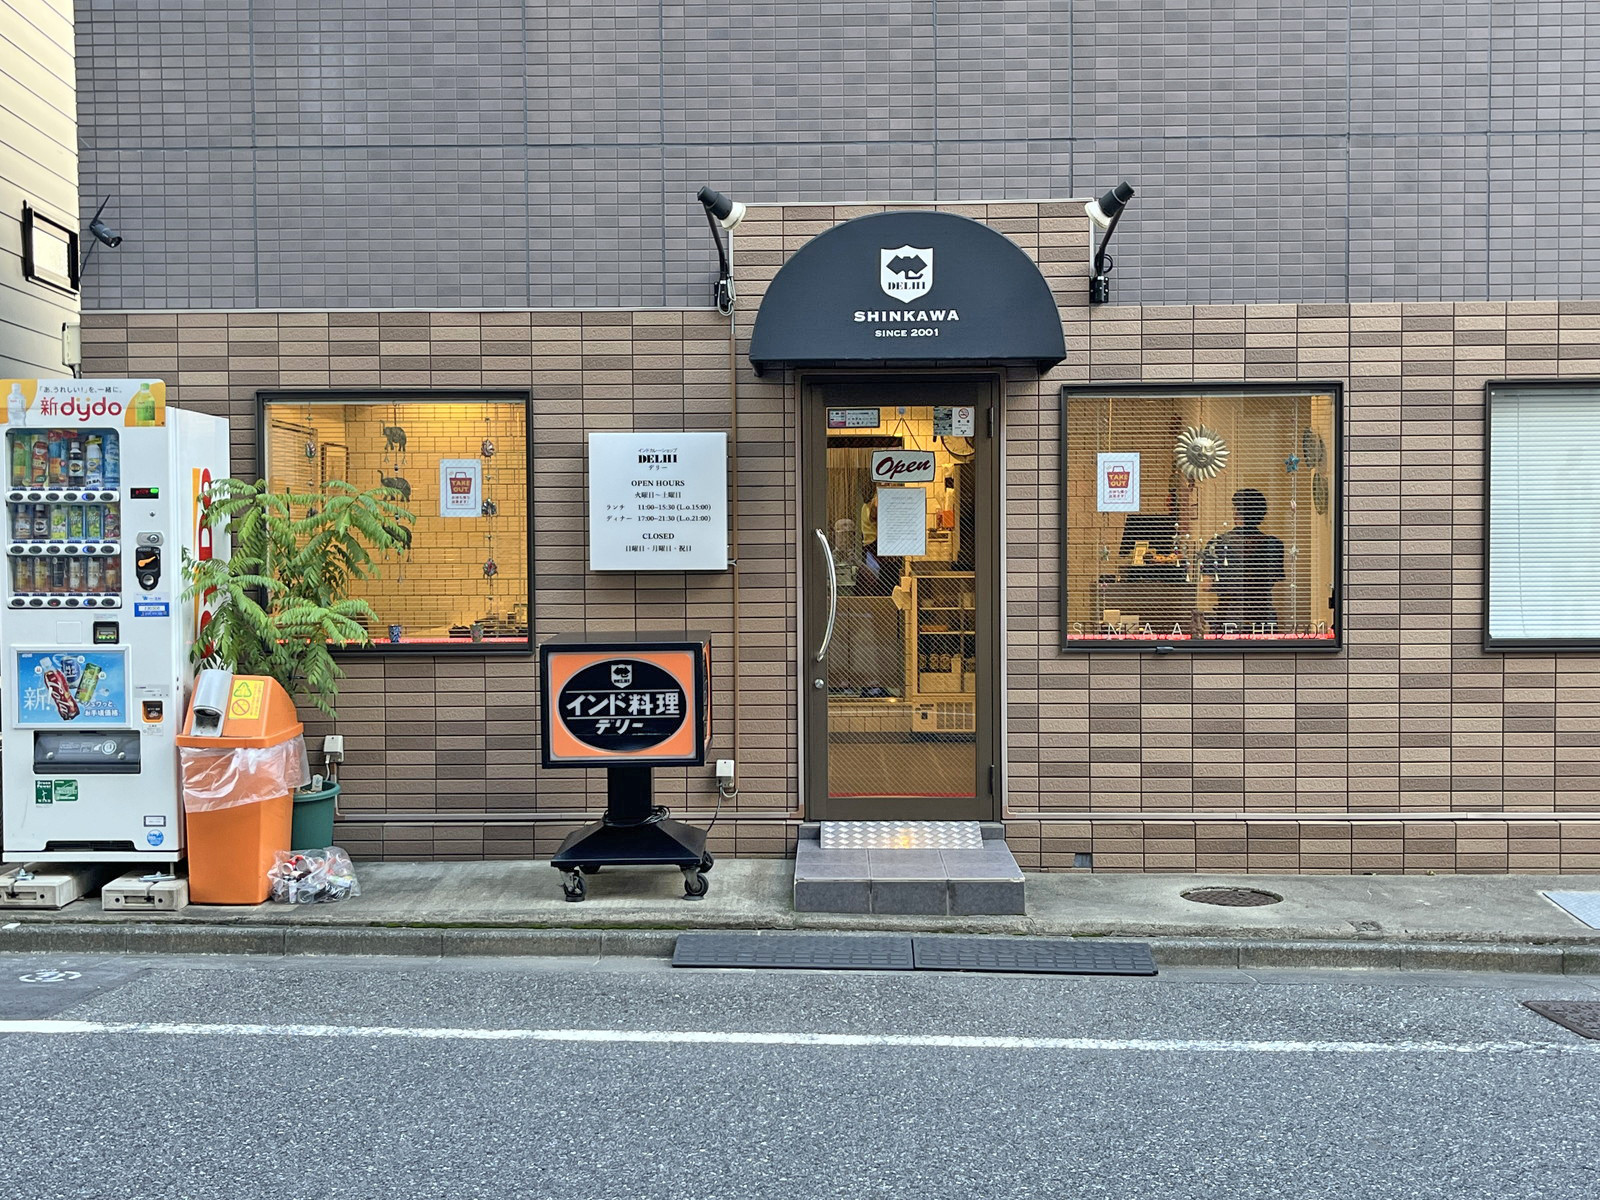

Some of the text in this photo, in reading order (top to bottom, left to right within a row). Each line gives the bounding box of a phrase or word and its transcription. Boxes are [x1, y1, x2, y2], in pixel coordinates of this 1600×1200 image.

[888, 281, 926, 290] DELHI
[853, 309, 959, 322] SHINKAWA
[874, 328, 939, 337] SINCE 2001
[638, 454, 678, 463] DELHI
[875, 456, 931, 480] Open
[566, 692, 680, 716] インド料理
[595, 718, 644, 735] デリー
